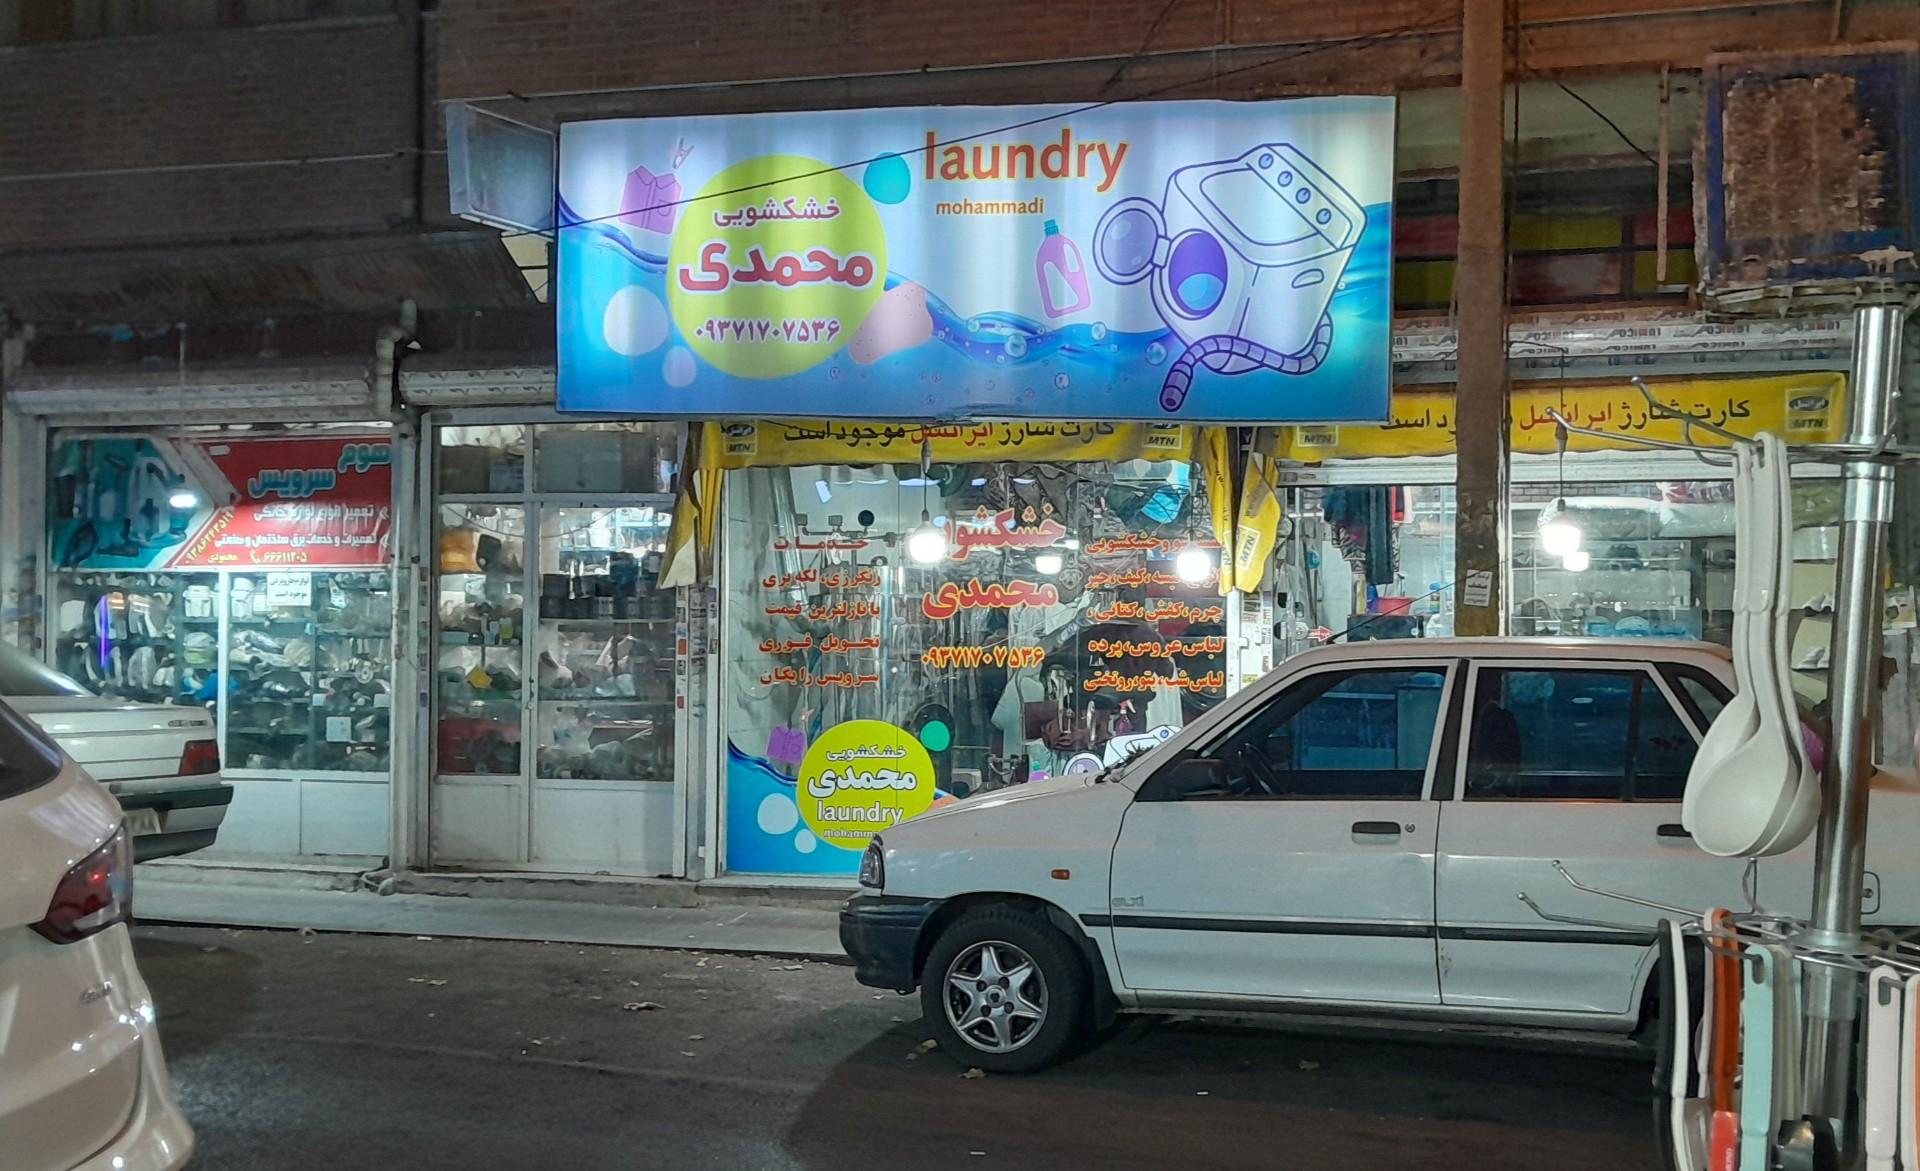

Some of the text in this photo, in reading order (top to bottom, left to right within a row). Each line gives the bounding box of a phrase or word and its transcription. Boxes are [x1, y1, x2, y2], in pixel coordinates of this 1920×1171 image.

[925, 128, 1128, 193] laundry
[714, 198, 841, 227] خشکشویی
[935, 197, 1045, 215] mohammadi
[678, 242, 874, 292] محمدی
[696, 318, 841, 342] ۰۹۳۷۱۷۰۷۵۳۶
[1147, 435, 1176, 446] MTN
[1303, 433, 1332, 444] MTN
[248, 468, 337, 498] سرویس
[943, 504, 1067, 561] خشکشو
[922, 577, 1060, 620] محمدی
[759, 632, 812, 653] فوری
[1183, 636, 1224, 659] لباس
[921, 646, 1046, 668] ۰۹۳۷۱۷۰۷۵۳۶
[816, 672, 880, 688] سرویس
[826, 745, 907, 762] خشکشویی
[807, 765, 918, 799] محمدی
[817, 800, 905, 827] laundry
